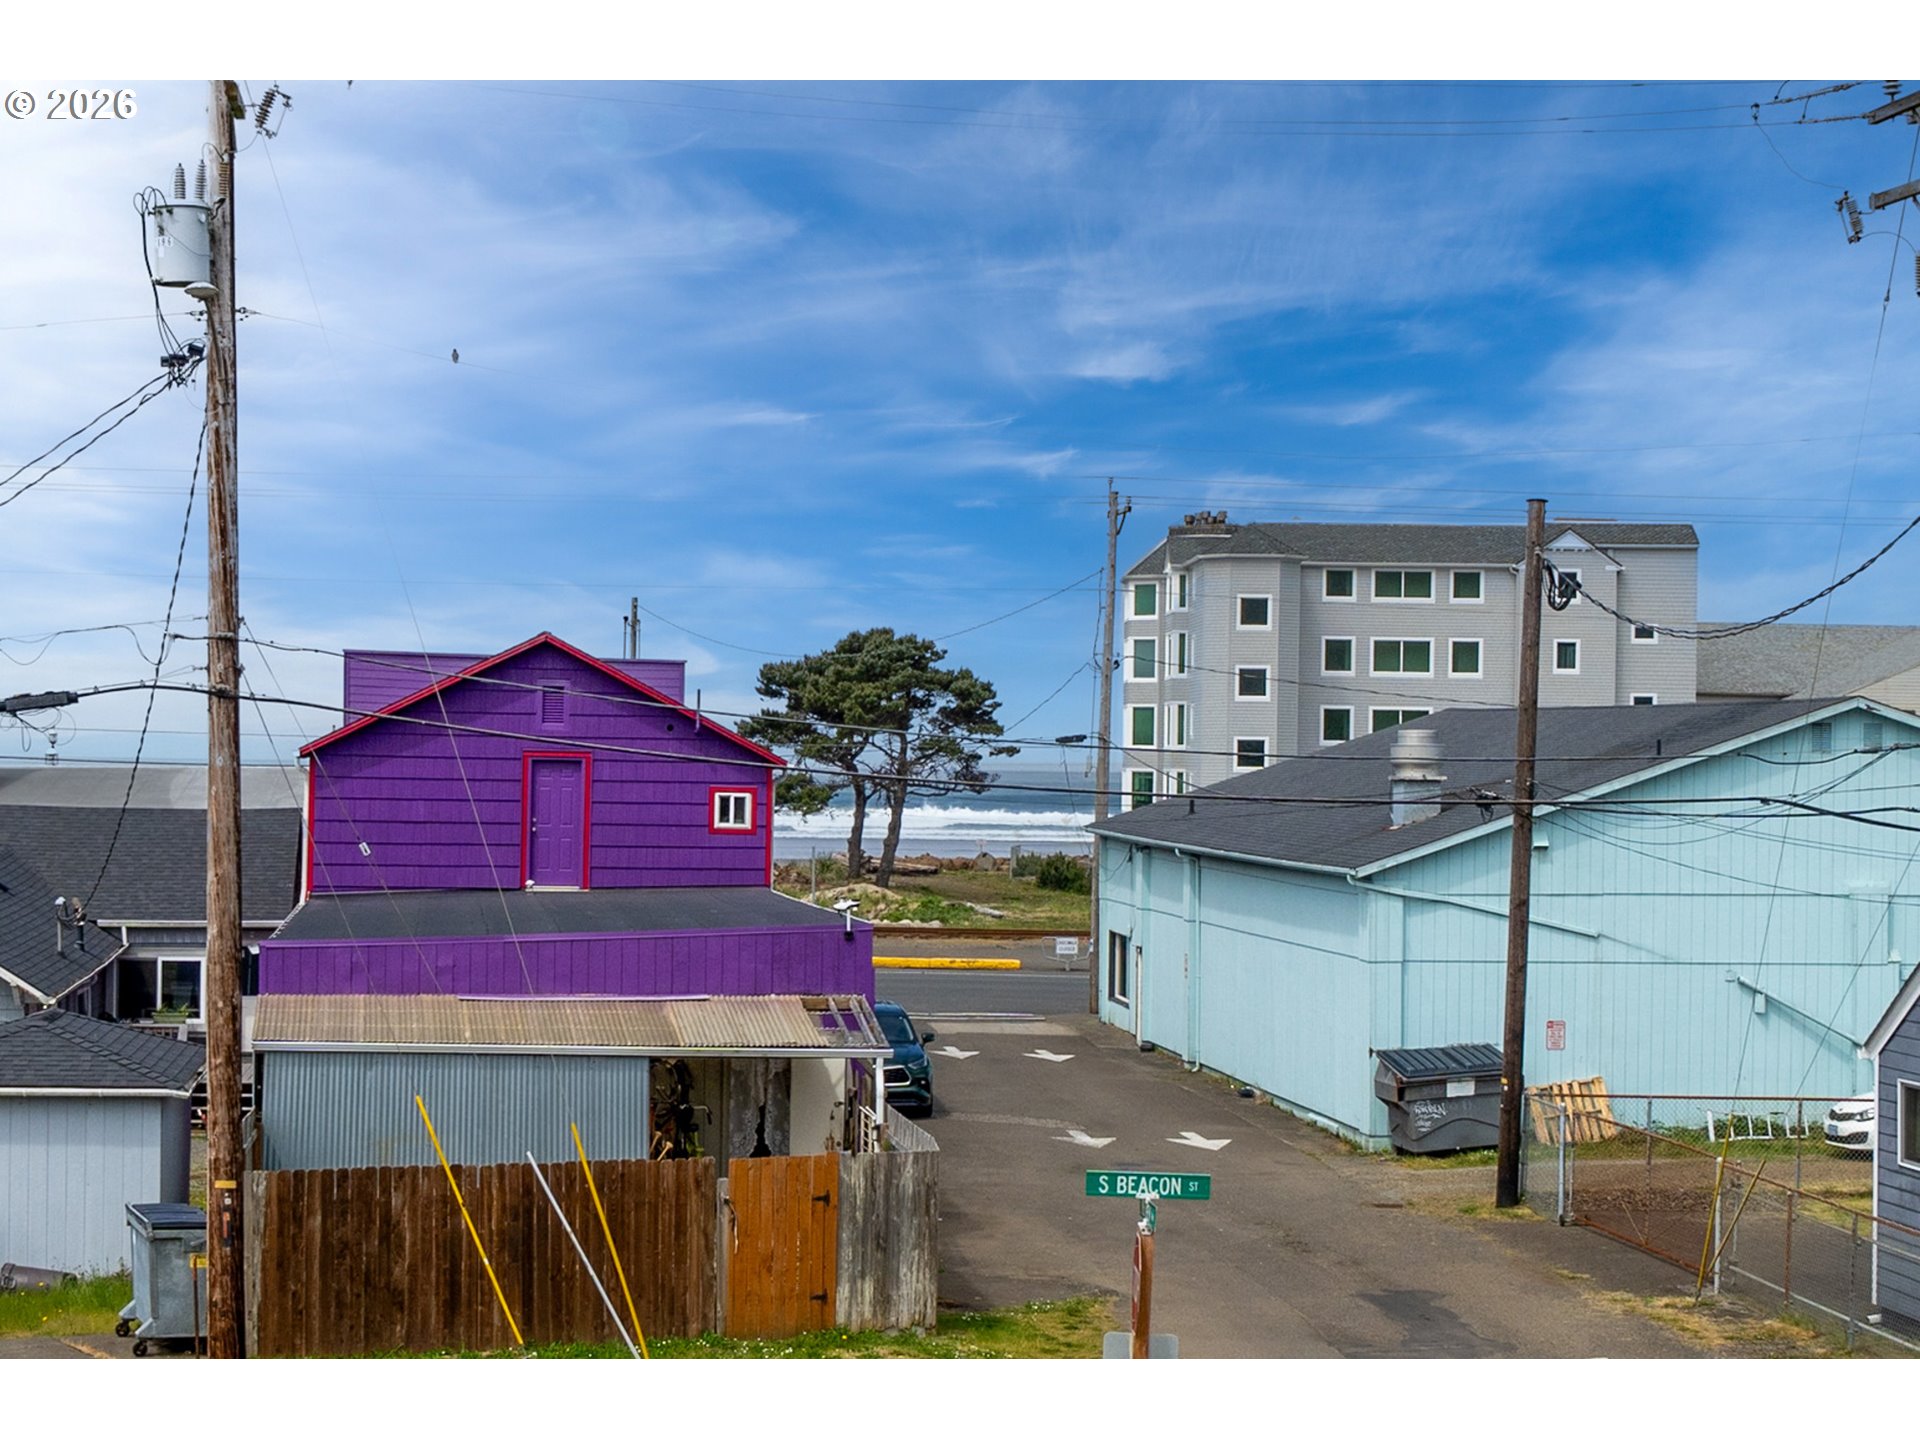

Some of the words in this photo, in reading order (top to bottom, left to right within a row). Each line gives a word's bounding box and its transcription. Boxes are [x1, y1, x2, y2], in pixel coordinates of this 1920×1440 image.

[1098, 1175, 1109, 1194] S
[1116, 1175, 1182, 1196] BEACON
[1188, 1181, 1199, 1192] ST
